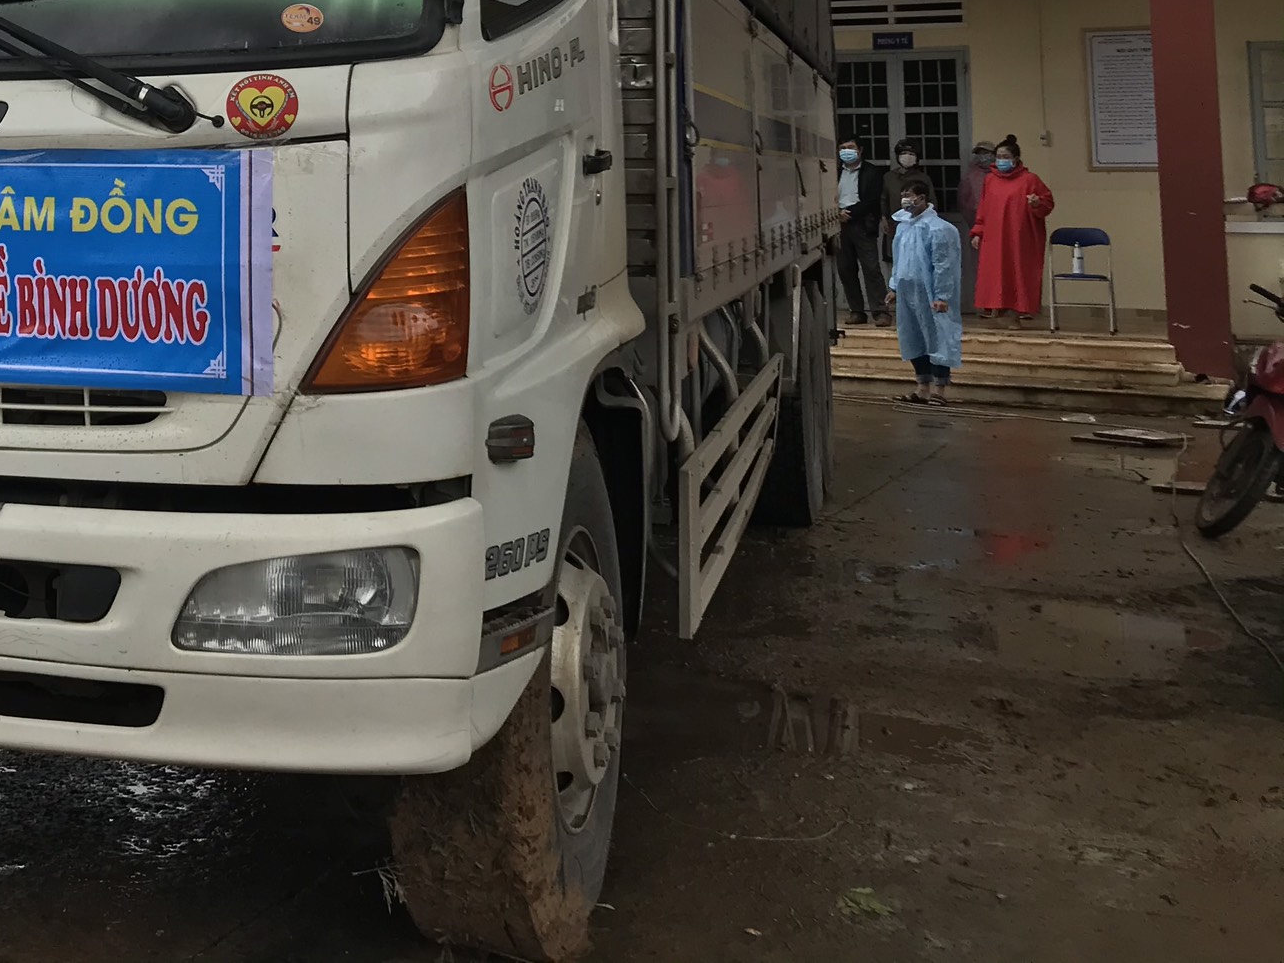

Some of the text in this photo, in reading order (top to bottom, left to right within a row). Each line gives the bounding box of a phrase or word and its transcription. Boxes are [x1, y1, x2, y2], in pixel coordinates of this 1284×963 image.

[307, 16, 321, 26] 49
[69, 177, 200, 236] ĐỒNG
[14, 256, 93, 341] BÌNH
[94, 265, 211, 346] DƯƠNG
